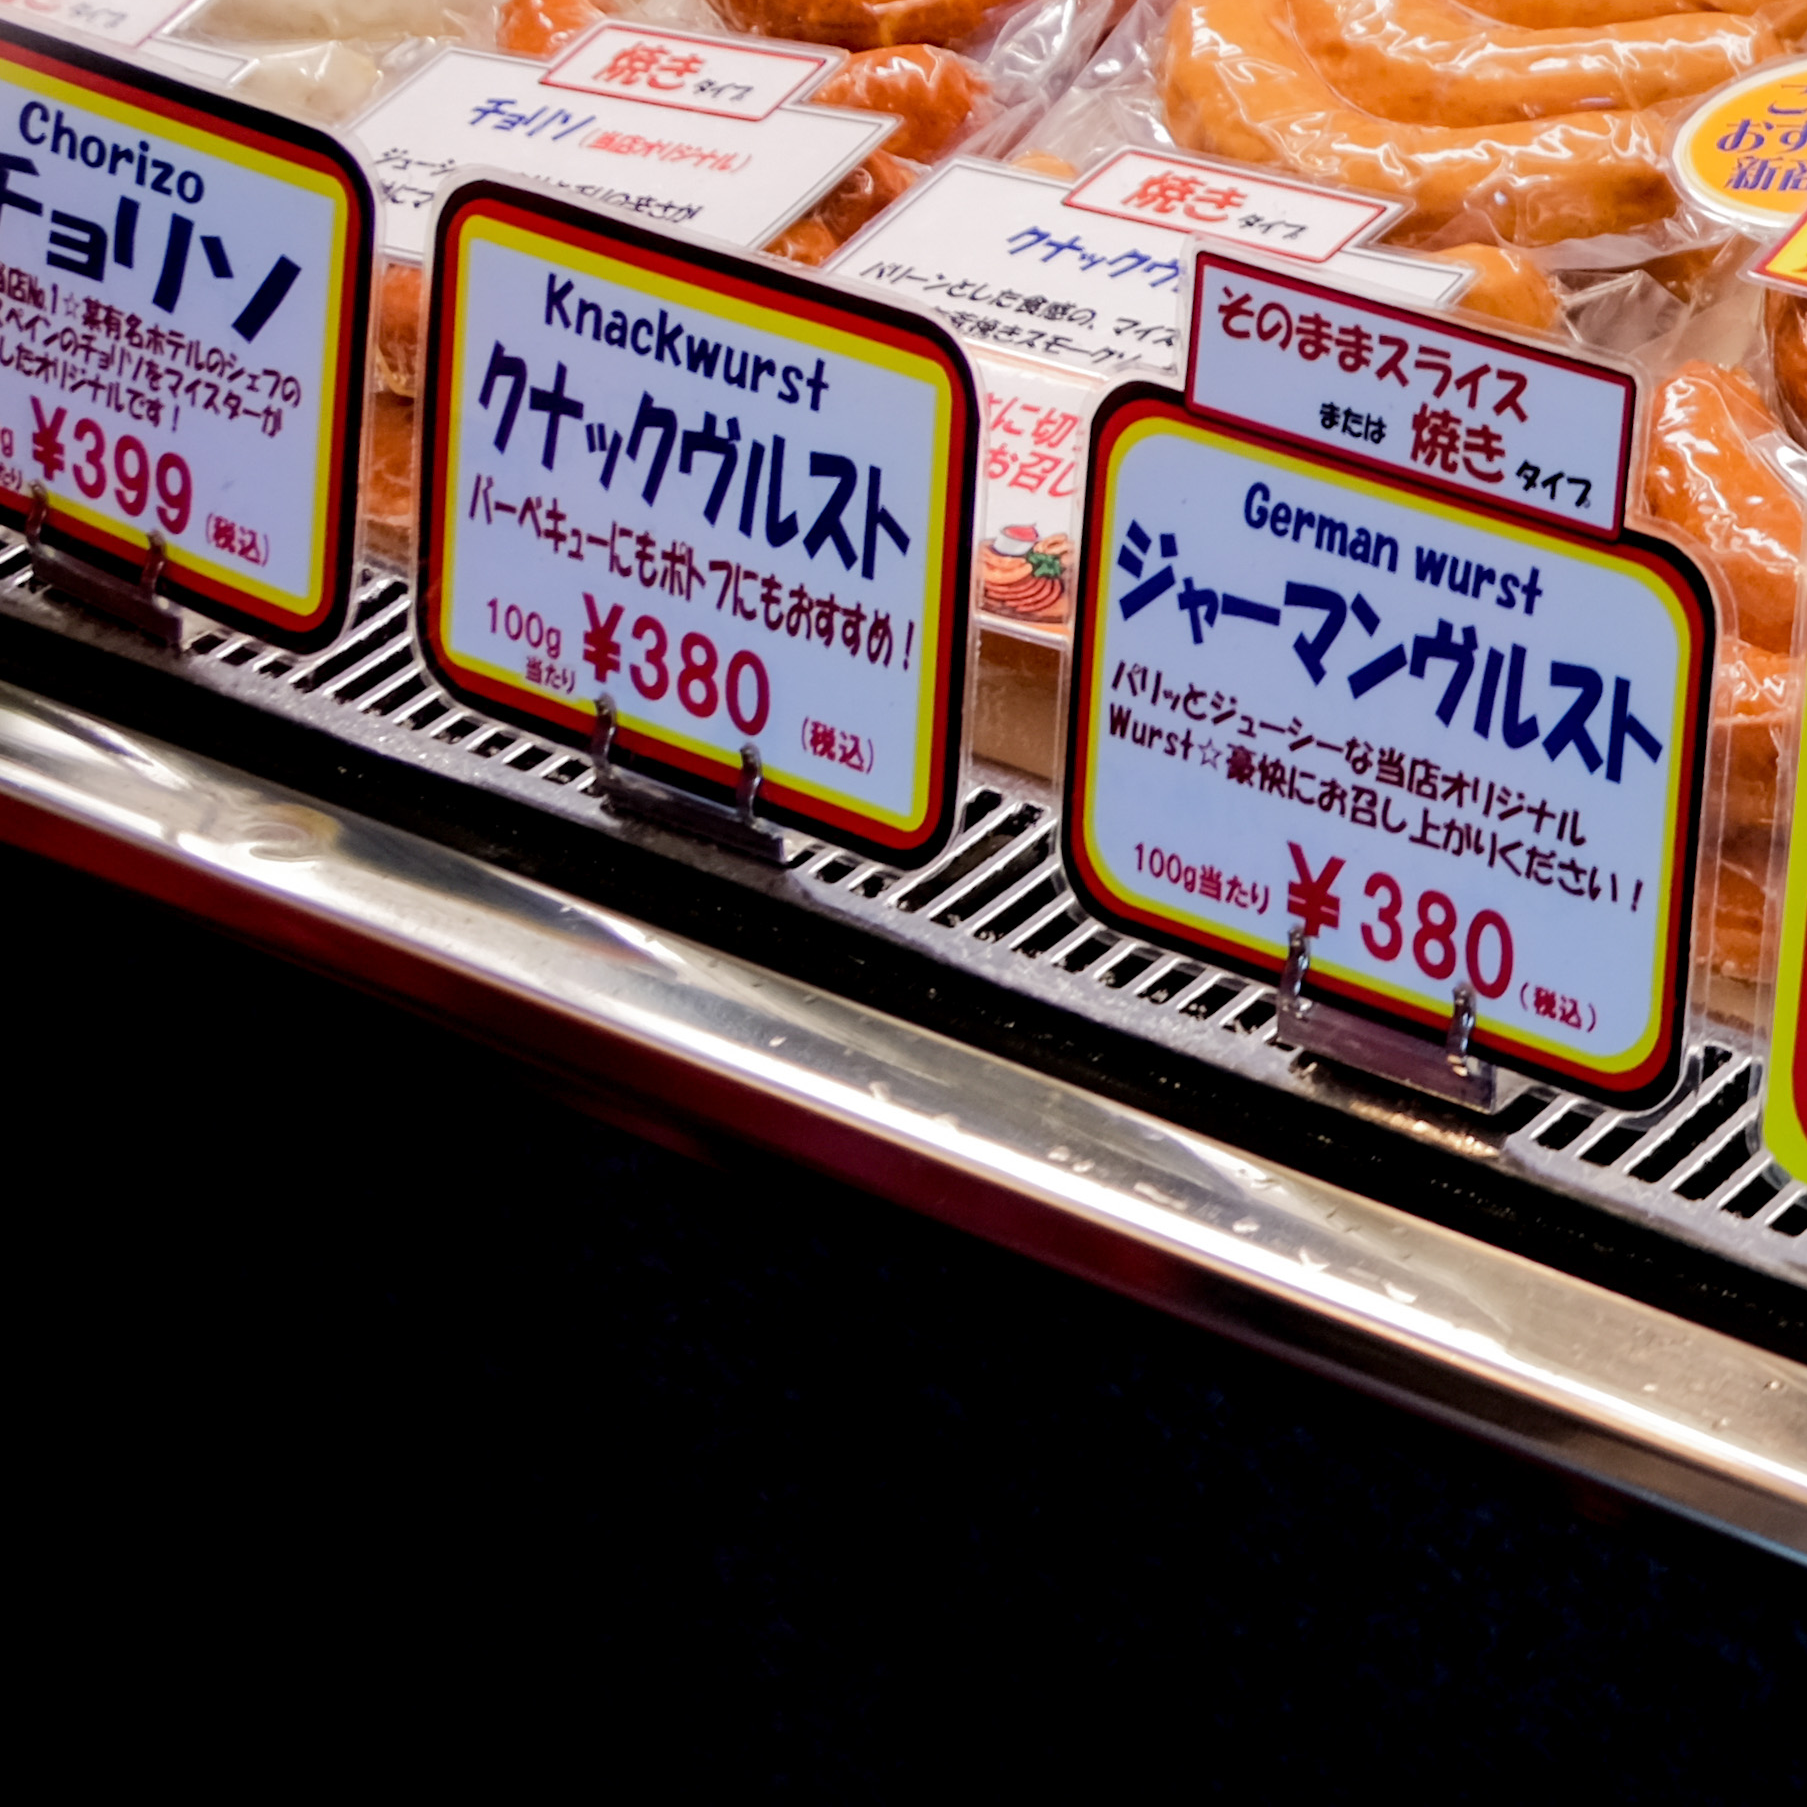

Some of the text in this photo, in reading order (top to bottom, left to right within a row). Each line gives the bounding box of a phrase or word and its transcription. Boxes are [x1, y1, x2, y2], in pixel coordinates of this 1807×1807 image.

[593, 40, 706, 93] 焼き
[18, 100, 204, 204] Chorizo
[1120, 170, 1249, 226] 焼き
[1236, 211, 1309, 242] タイプ
[545, 272, 830, 412] Knackwurst
[1218, 286, 1530, 423] そのままスライス
[30, 394, 270, 568] ¥399 (税込)
[477, 341, 911, 581] クナックヴルスト
[1318, 399, 1594, 510] または 焼き タイプ
[468, 473, 917, 671] バーベキューにもポトフにもおすすめ！
[1243, 481, 1544, 619] German wurst
[485, 593, 876, 775] 100g ¥380 (税込)
[524, 654, 577, 694] 当たり
[1116, 520, 1665, 787] ジャーマンヴルスト
[1110, 659, 1587, 848] パリッとジューシーな当店オリジナル
[1132, 839, 1599, 1034] 100g当たり ¥380 (税込)
